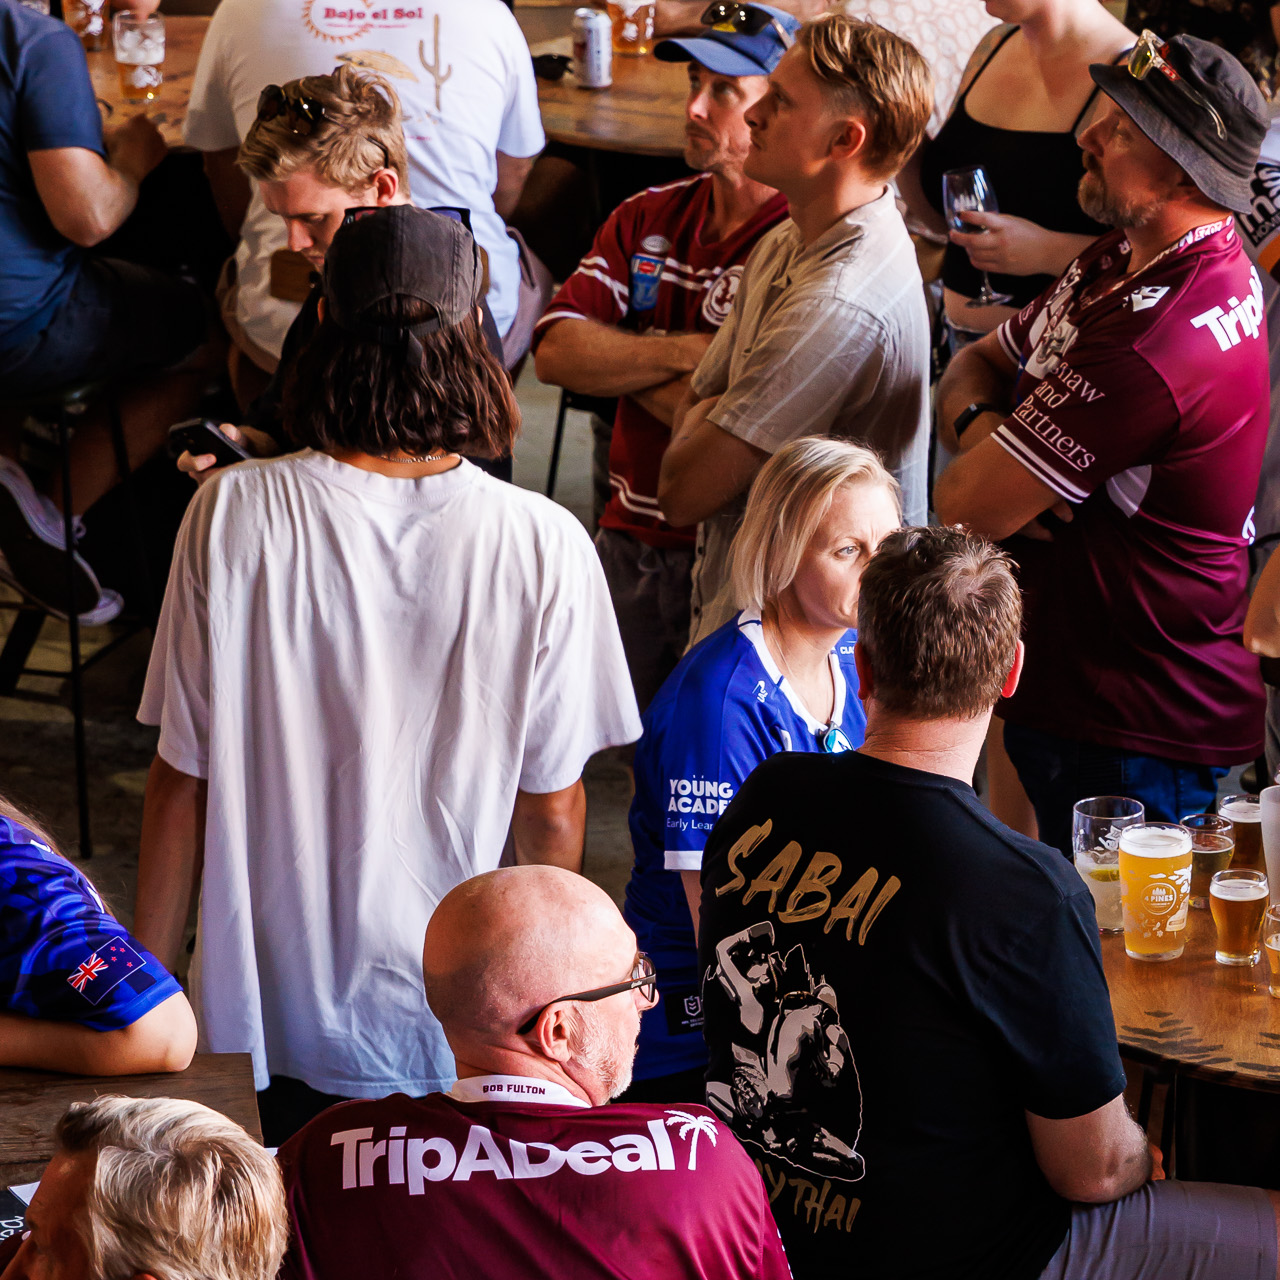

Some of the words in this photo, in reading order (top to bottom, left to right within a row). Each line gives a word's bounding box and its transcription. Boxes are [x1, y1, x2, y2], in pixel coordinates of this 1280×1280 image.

[324, 8, 366, 22] Bajo
[372, 9, 387, 20] el
[393, 7, 423, 19] Sol
[1034, 380, 1071, 409] and
[1014, 394, 1096, 469] Partners
[667, 797, 732, 817] ACADE
[666, 817, 689, 831] Early
[715, 818, 901, 946] SABAI
[482, 1083, 504, 1095] BOB
[506, 1084, 546, 1096] FULTON
[330, 1118, 676, 1196] TripADeal
